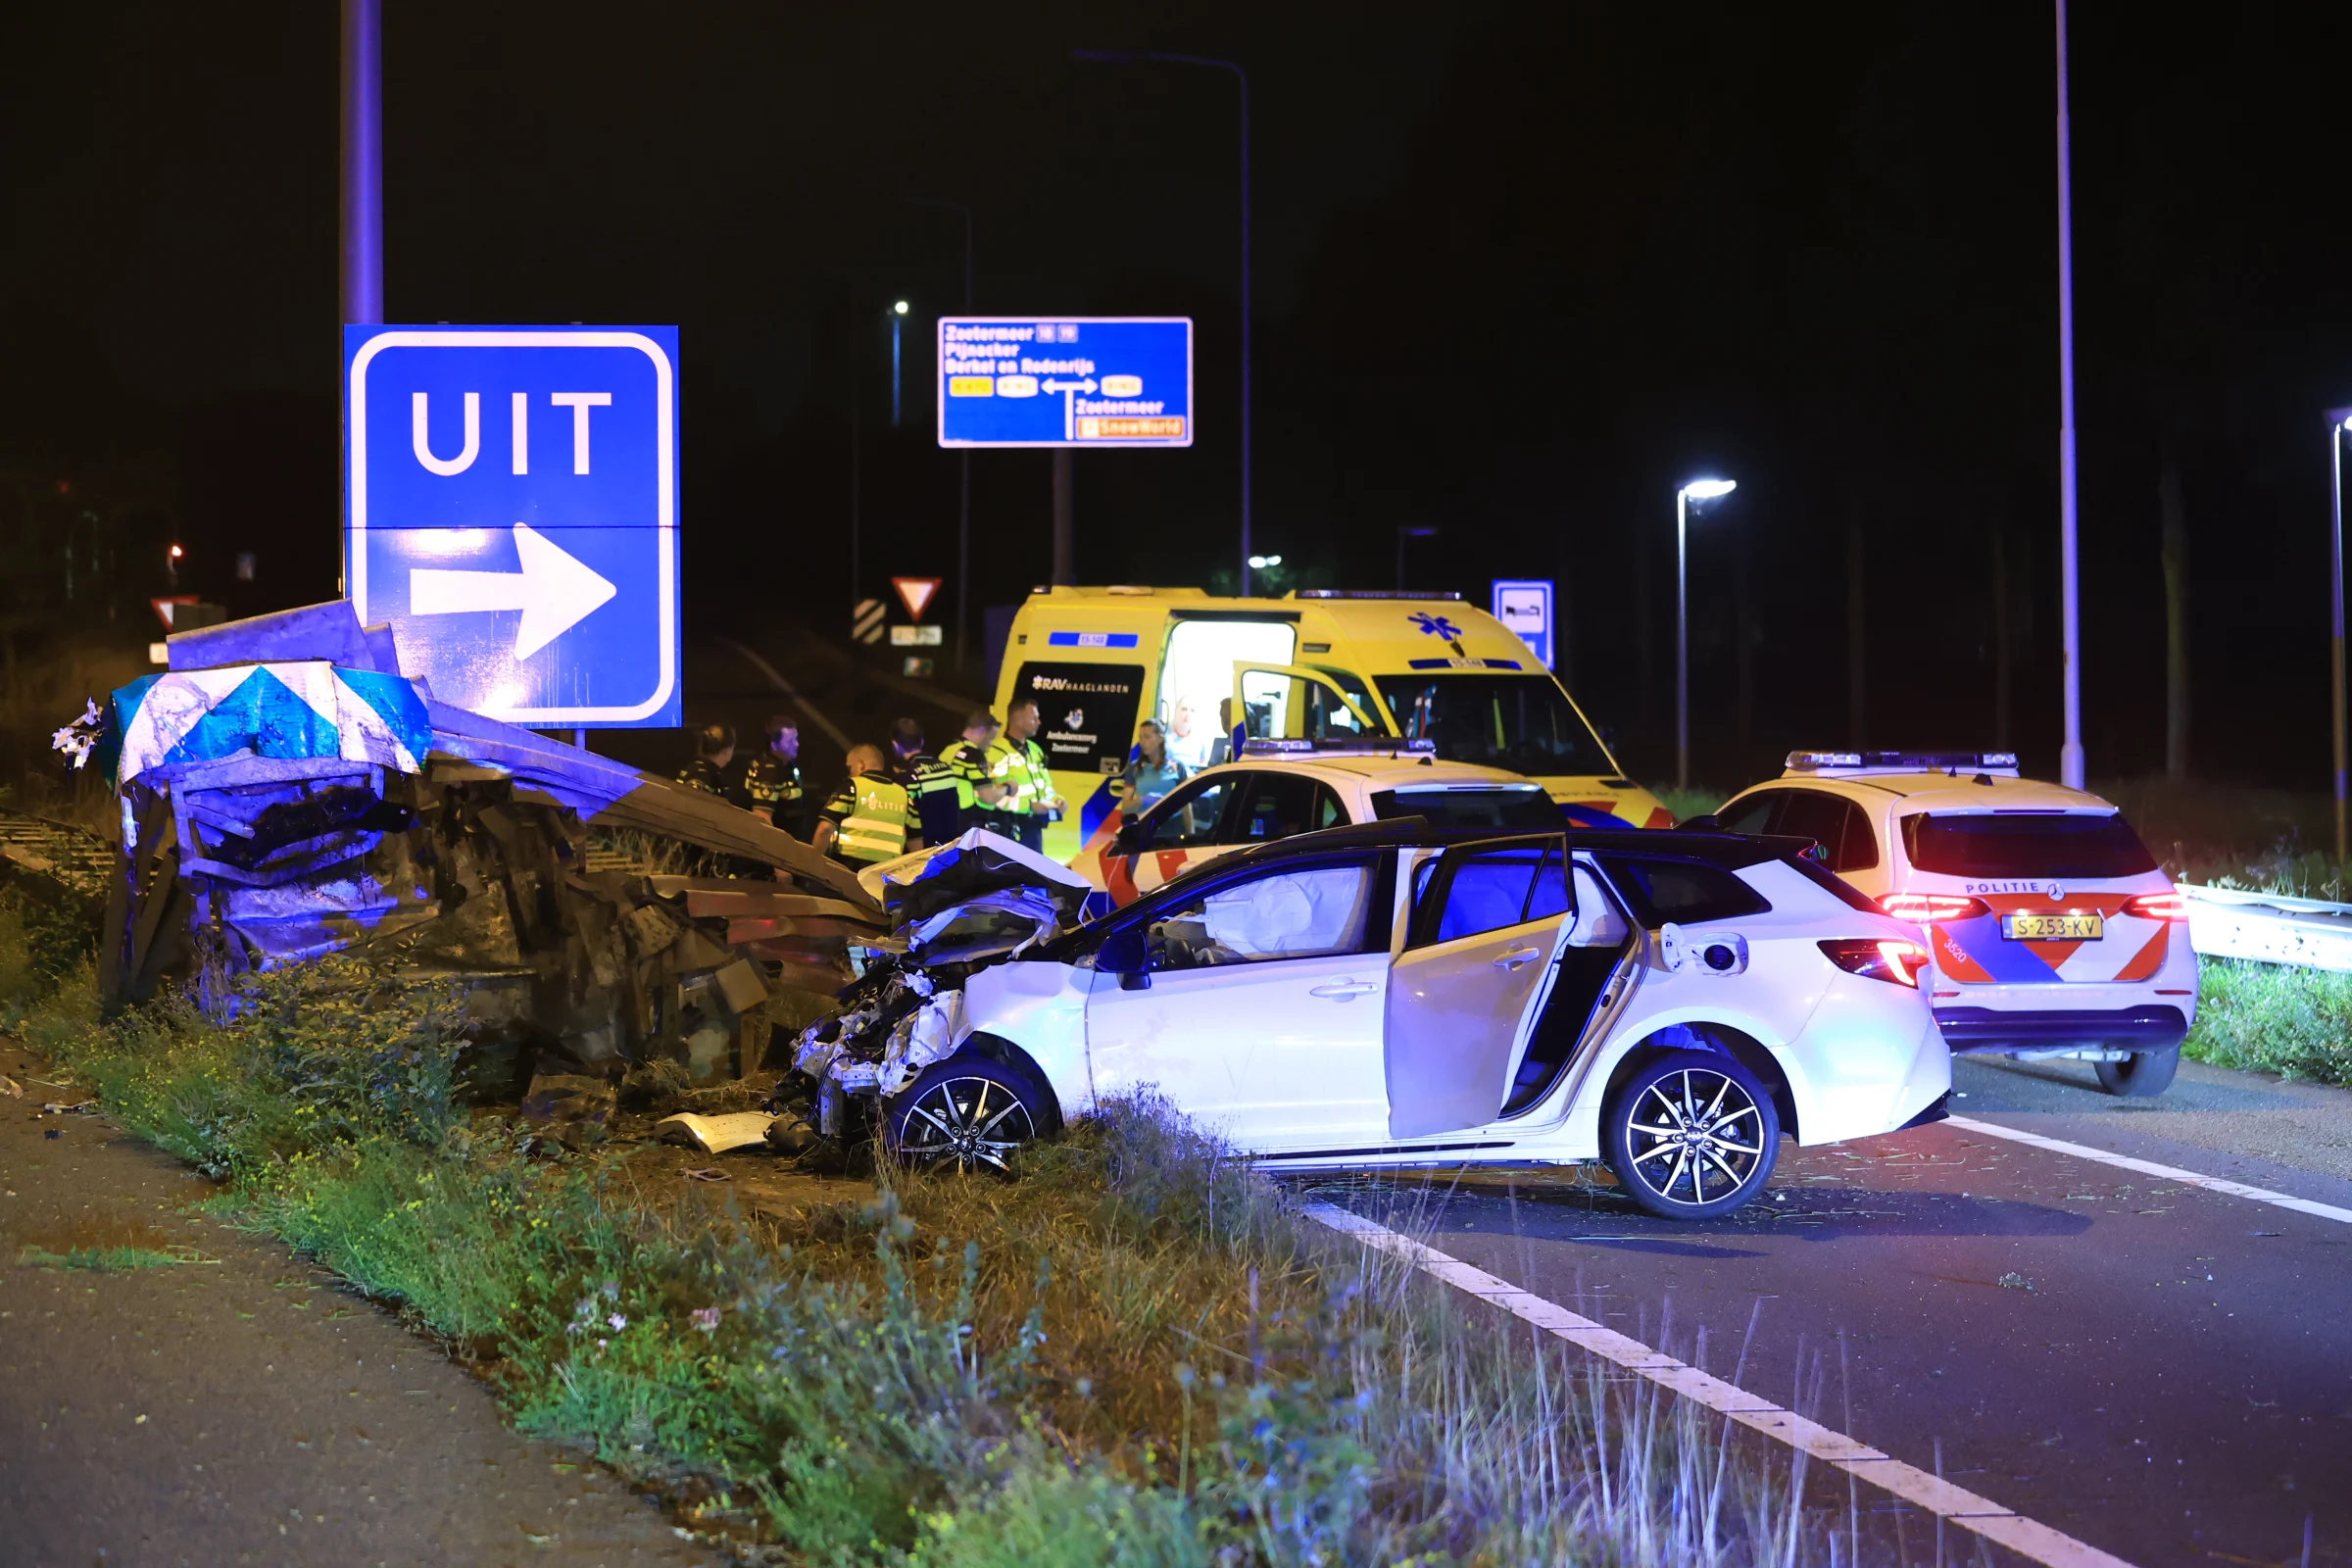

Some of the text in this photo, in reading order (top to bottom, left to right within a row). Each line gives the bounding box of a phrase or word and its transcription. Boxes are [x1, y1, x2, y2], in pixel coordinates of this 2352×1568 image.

[945, 324, 1035, 341] Zoetermeer
[945, 342, 1020, 361] Pijnacker
[945, 358, 1095, 376] Berkel en Rodenrijs
[1075, 398, 1165, 415] Zoetermeer
[412, 392, 612, 476] UIT
[1042, 677, 1129, 694] RAV HAAGLANDEN
[860, 791, 906, 812] POLITIE
[1965, 882, 2039, 894] POLITIE
[2018, 919, 2095, 936] S-253-KV
[1943, 938, 1968, 962] 3520
